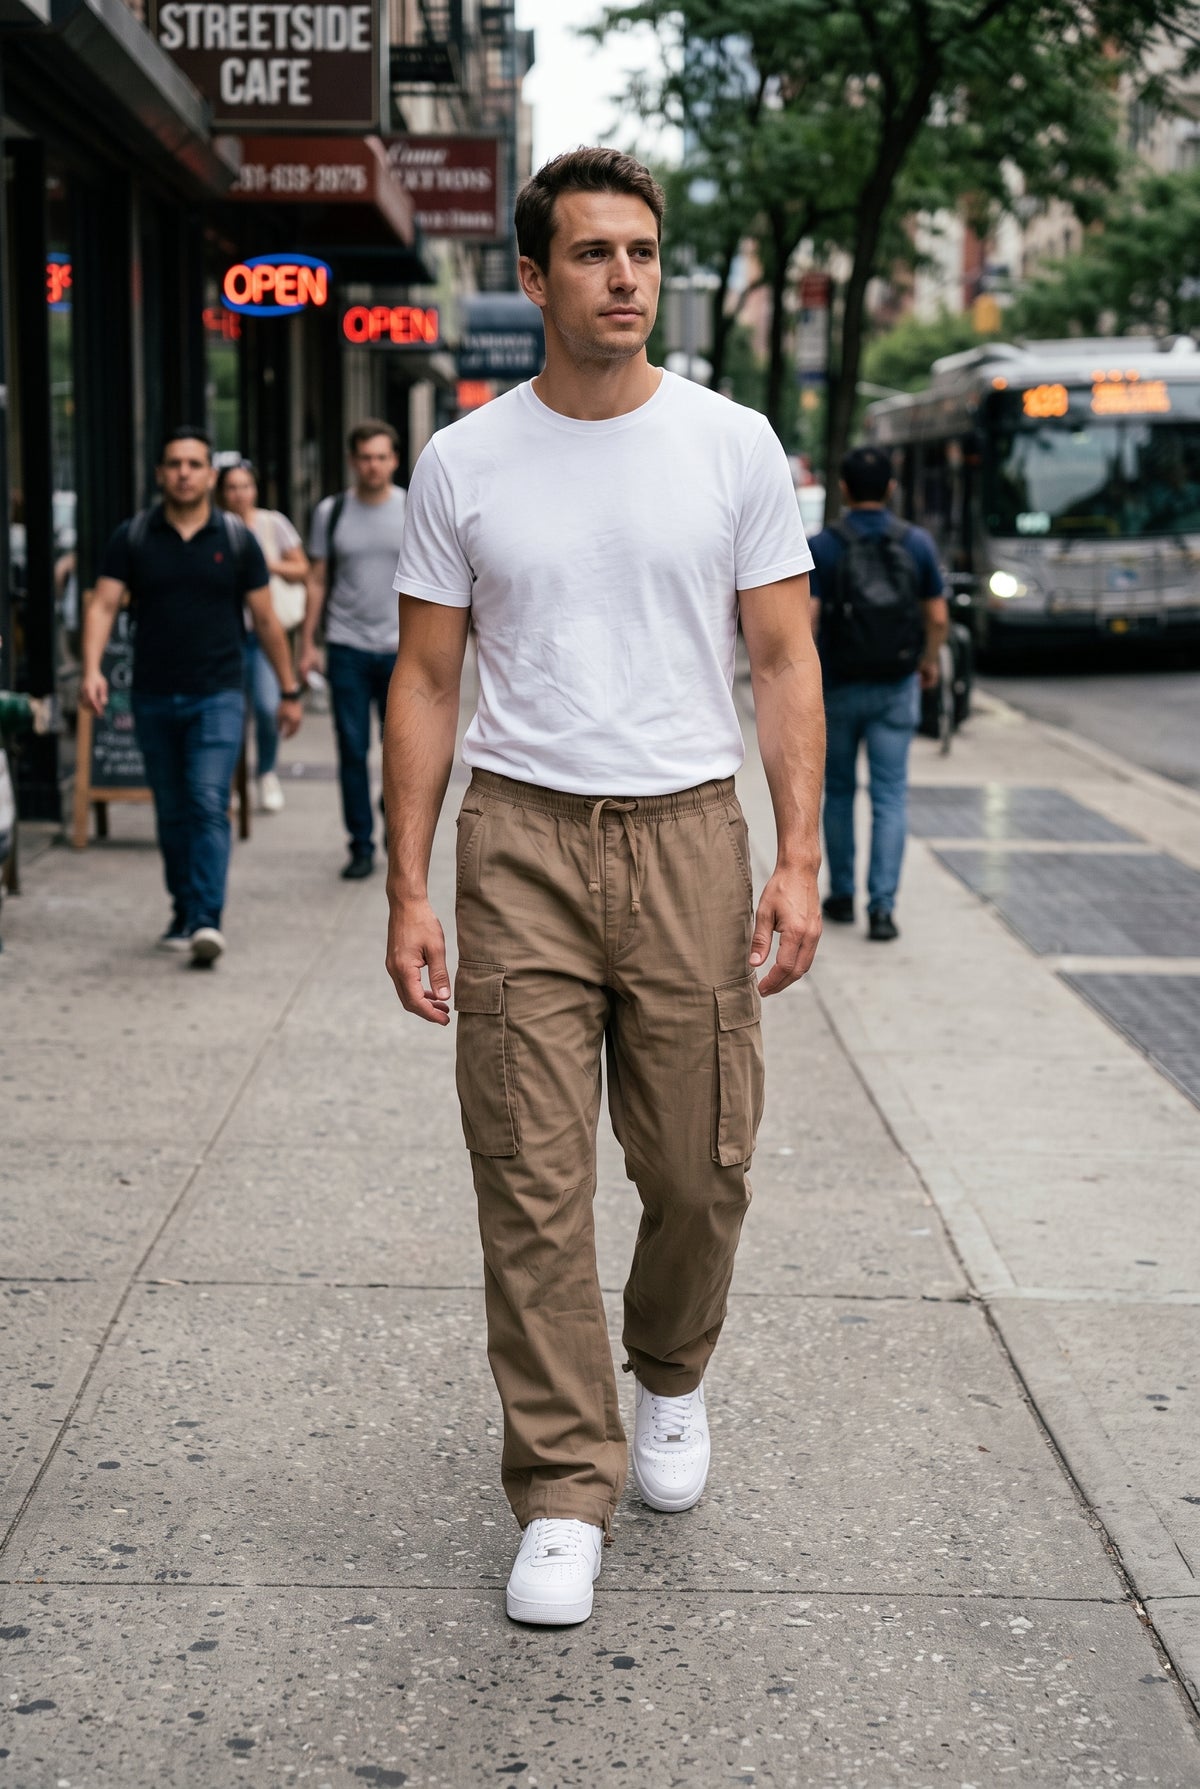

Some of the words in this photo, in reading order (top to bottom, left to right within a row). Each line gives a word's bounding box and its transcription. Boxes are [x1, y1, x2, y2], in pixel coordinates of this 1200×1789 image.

[160, 4, 371, 51] STREETSIDE
[220, 57, 312, 105] CAFE
[223, 264, 328, 307] OPEN
[343, 306, 438, 344] OPEN
